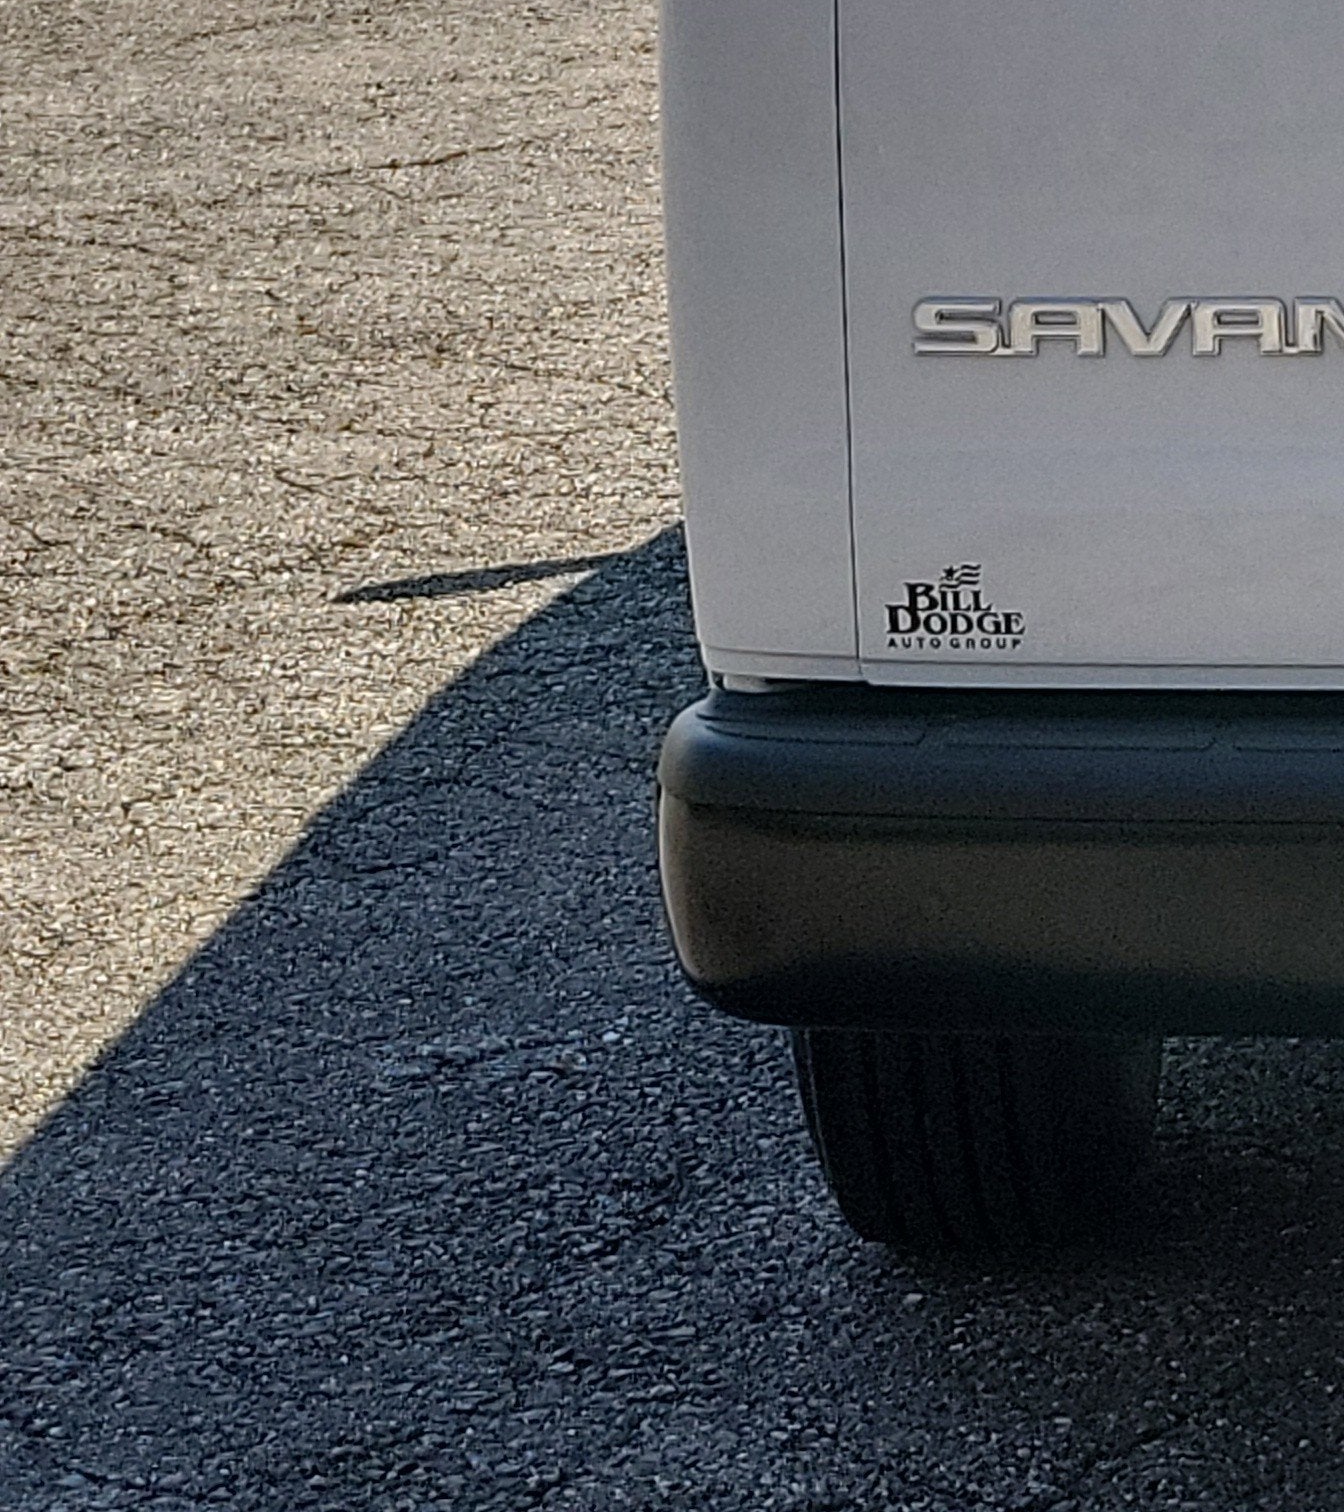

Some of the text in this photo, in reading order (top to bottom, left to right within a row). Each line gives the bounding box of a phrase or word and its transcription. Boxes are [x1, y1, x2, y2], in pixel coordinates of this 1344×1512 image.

[903, 582, 993, 612] BILL
[884, 604, 1026, 635] DODGE
[888, 638, 1022, 650] AUTO GROUP
